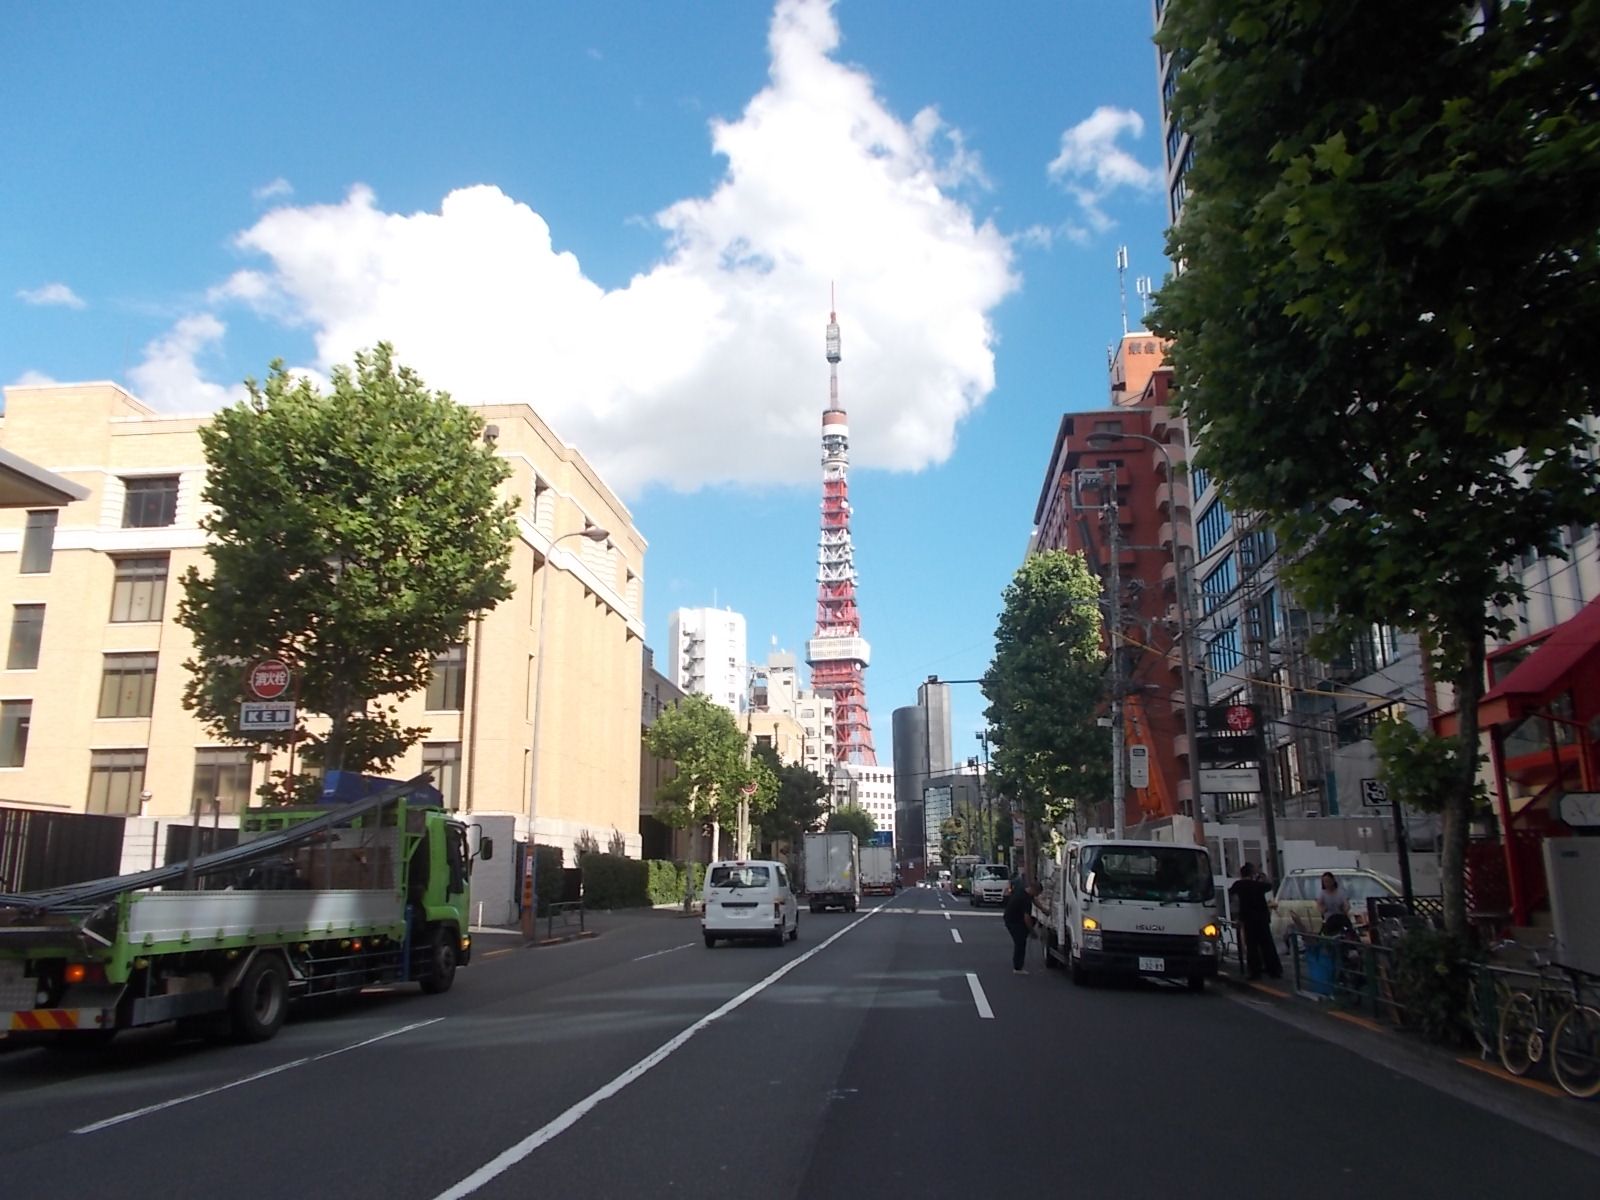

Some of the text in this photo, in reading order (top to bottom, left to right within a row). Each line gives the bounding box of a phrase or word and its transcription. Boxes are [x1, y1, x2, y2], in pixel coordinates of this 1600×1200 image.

[255, 671, 287, 686] 消火栓
[248, 711, 287, 722] KEN
